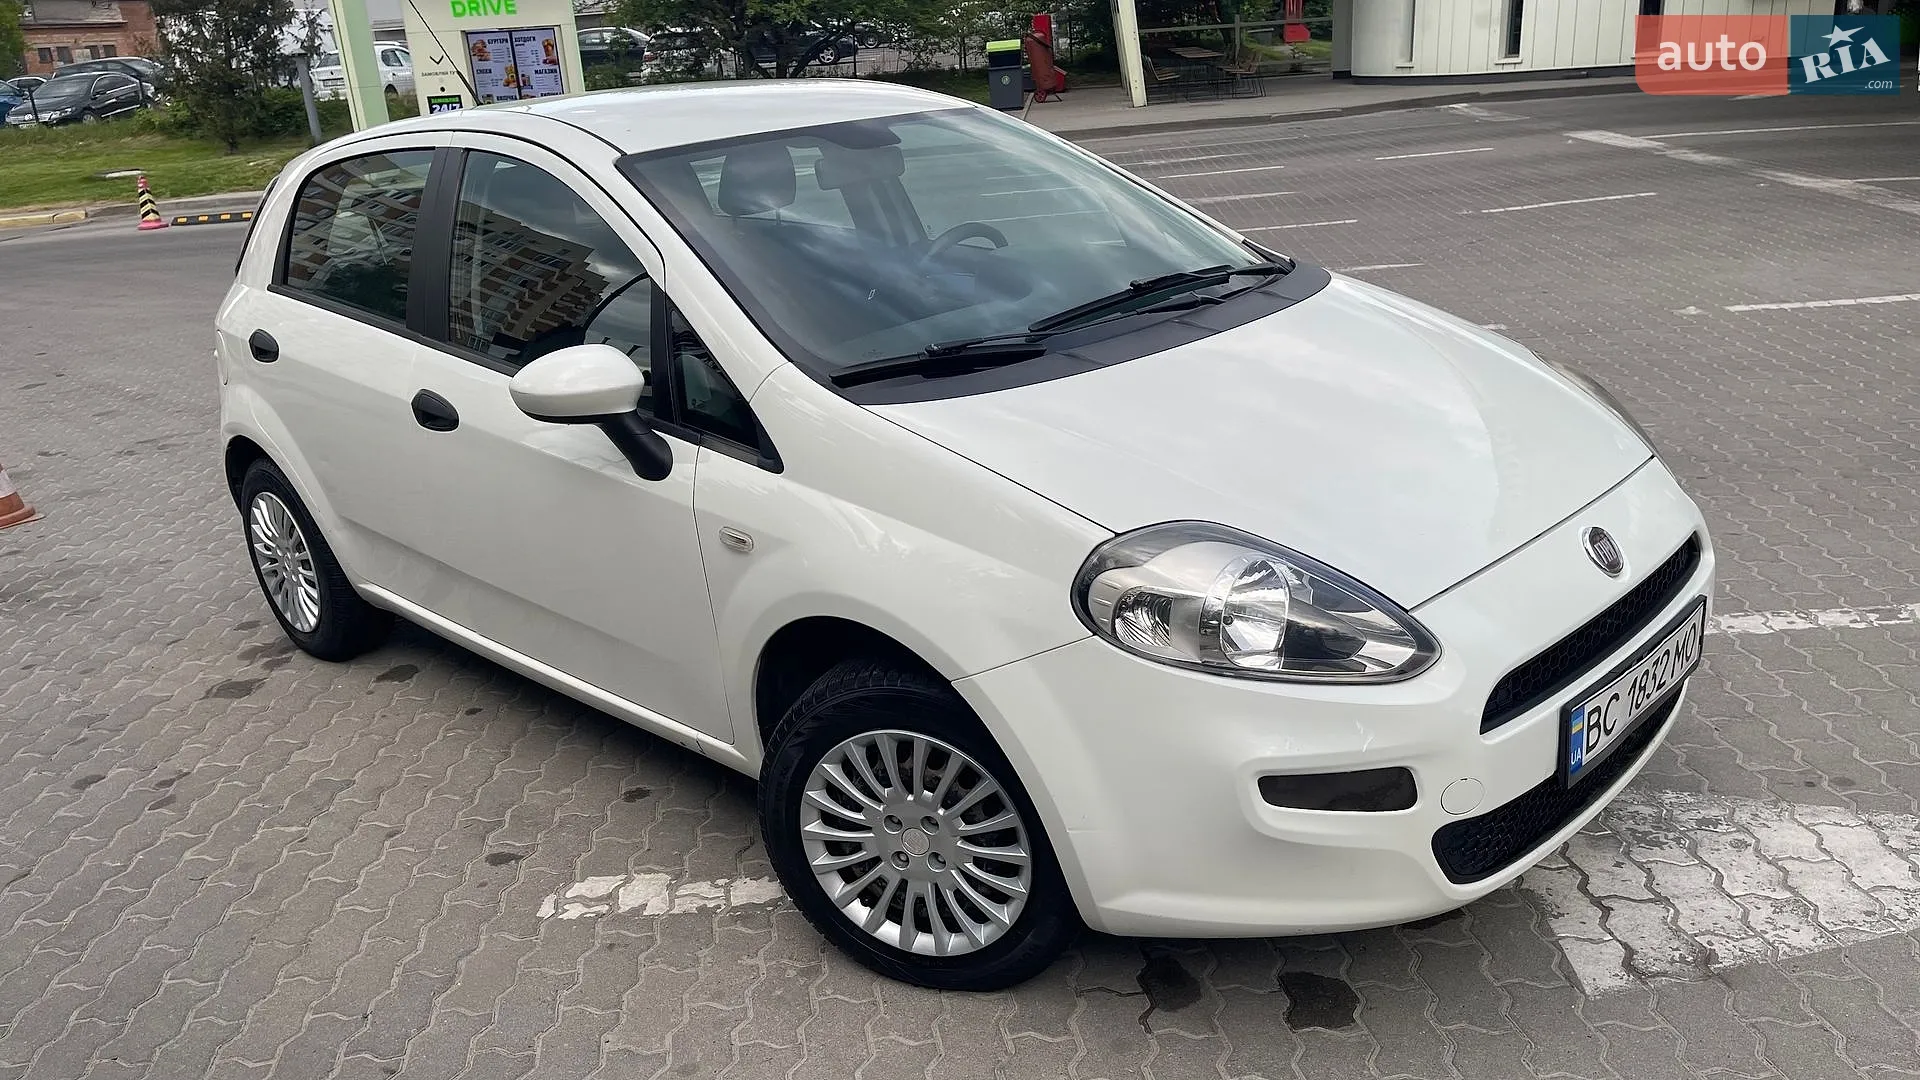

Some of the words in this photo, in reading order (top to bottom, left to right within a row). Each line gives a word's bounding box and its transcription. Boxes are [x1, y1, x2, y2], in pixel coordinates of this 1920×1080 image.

[450, 0, 517, 17] DRIVE
[431, 103, 460, 113] 24/7
[1585, 692, 1620, 756] BC
[1627, 649, 1670, 718] 1832
[1670, 622, 1696, 680] MO
[1571, 750, 1582, 765] UA
